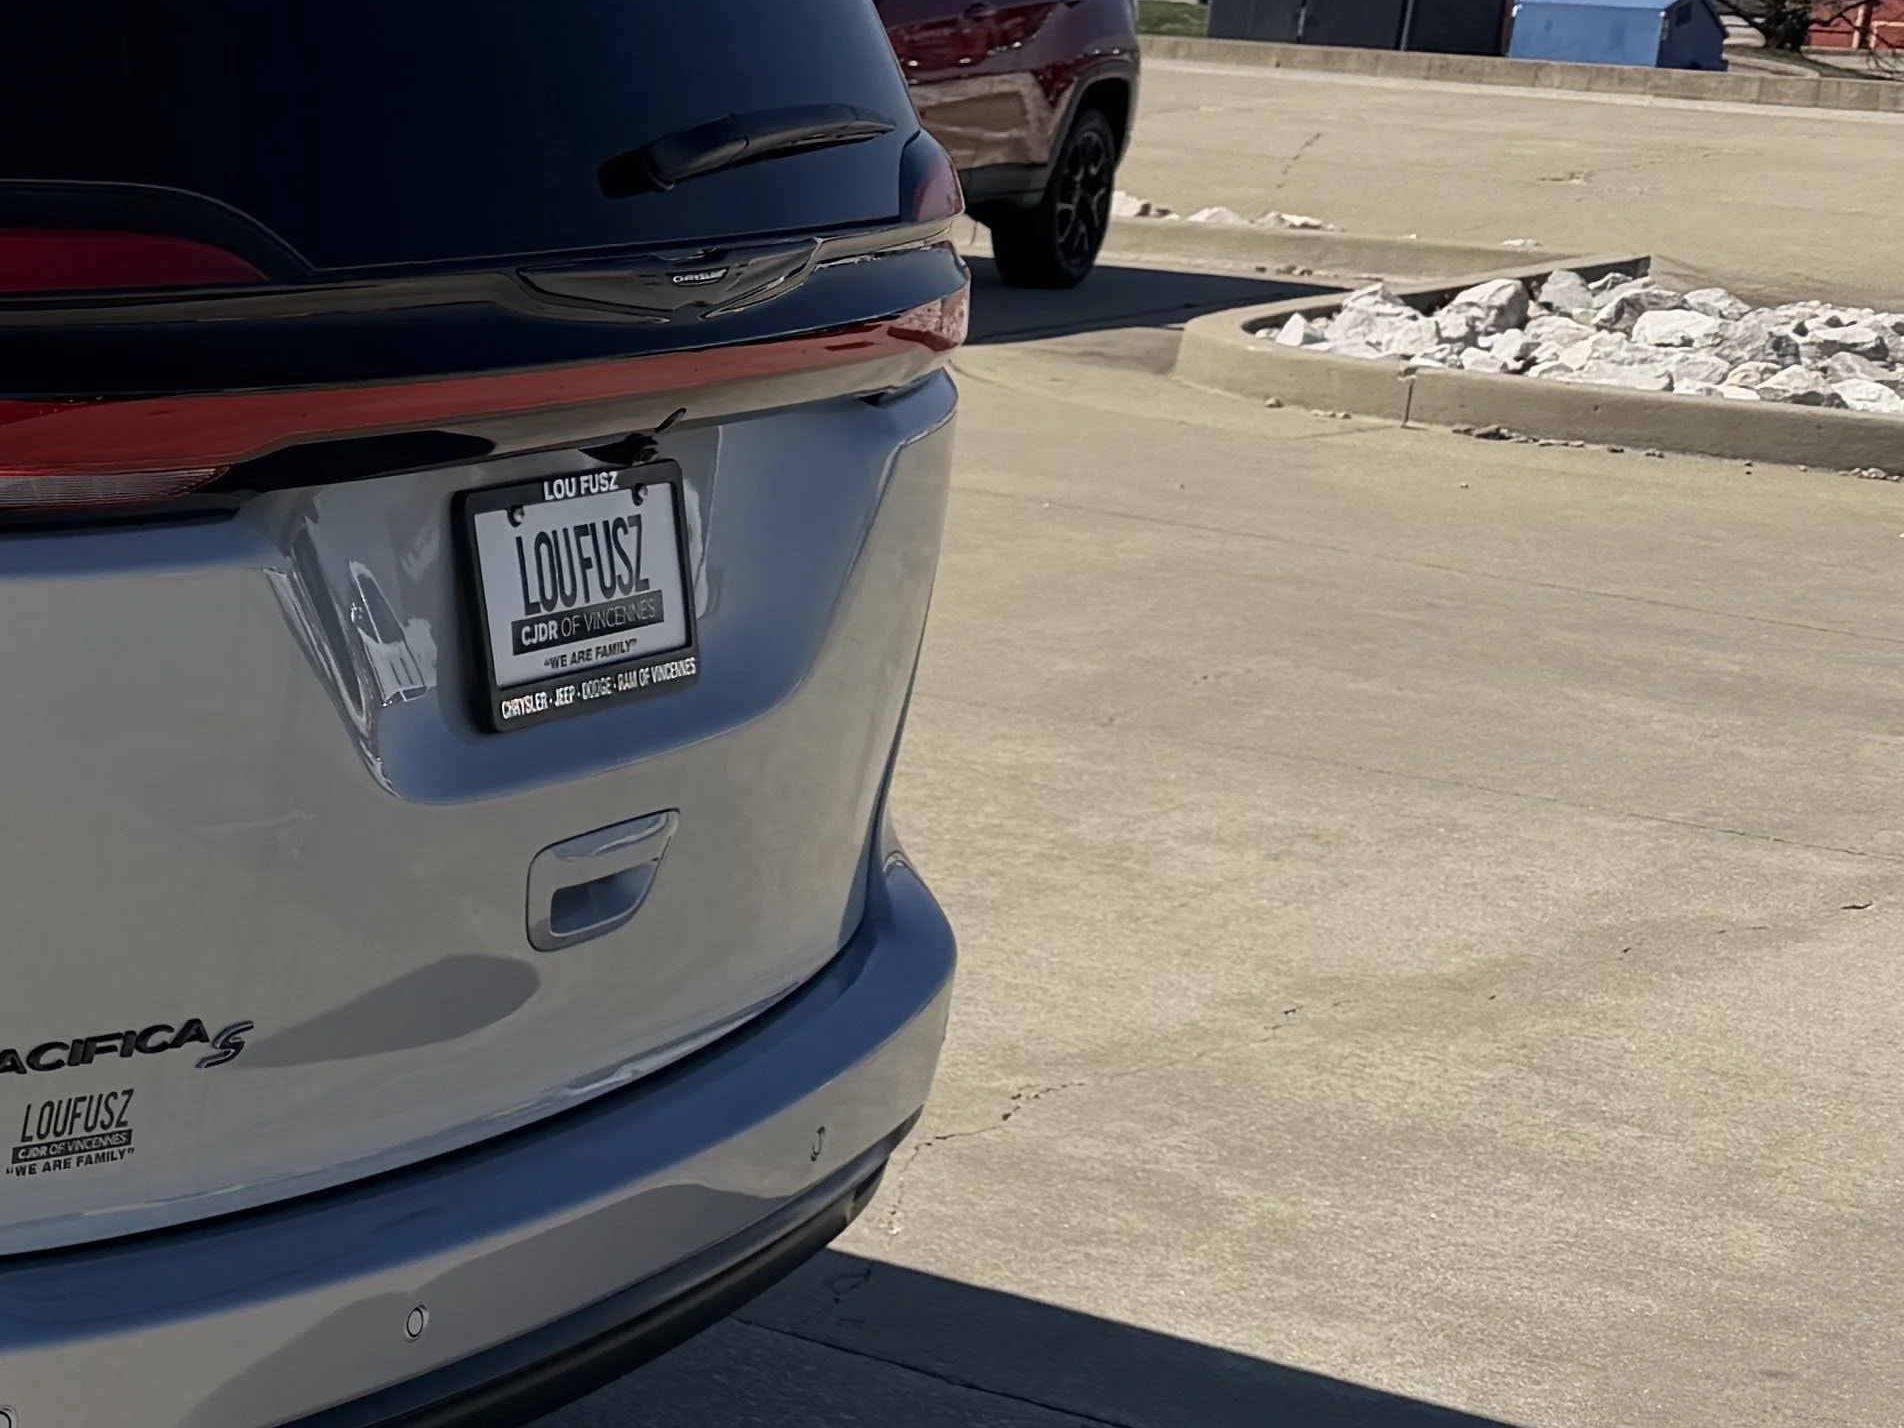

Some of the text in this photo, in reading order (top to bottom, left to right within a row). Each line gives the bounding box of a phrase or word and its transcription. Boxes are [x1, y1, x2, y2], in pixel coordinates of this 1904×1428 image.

[543, 471, 619, 501] LOU FUSZ
[521, 598, 656, 647] CJDR OF VINCENNES
[570, 648, 593, 666] ARE
[501, 657, 697, 719] CHRYSLER JEEP DODGE RAM OF VINCENNES
[195, 1020, 254, 1069] S
[42, 1157, 72, 1173] ARE
